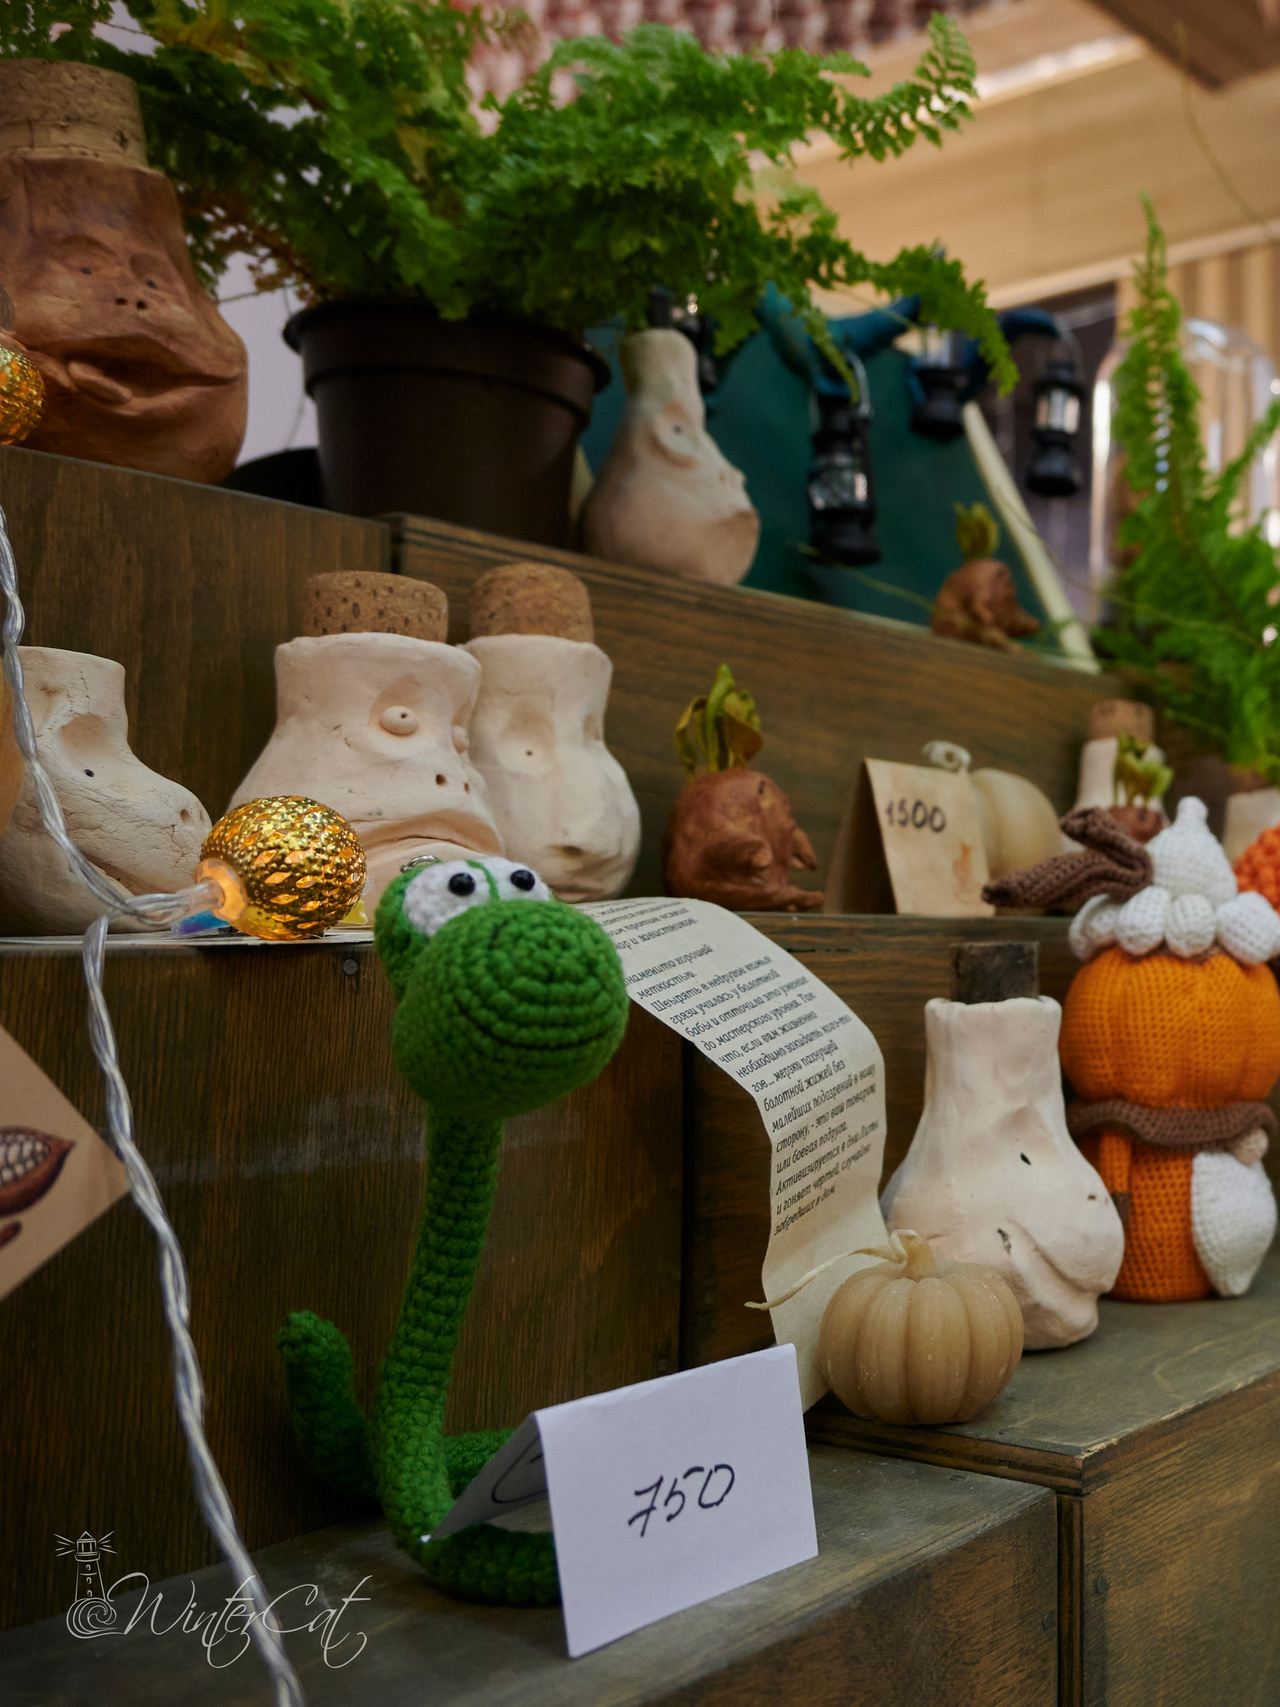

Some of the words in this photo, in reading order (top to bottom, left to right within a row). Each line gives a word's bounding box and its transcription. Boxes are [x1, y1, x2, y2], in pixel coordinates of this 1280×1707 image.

[886, 798, 946, 833] 1500
[632, 937, 640, 945] и
[638, 918, 698, 942] завистников.
[675, 944, 713, 964] хорошей
[637, 971, 697, 999] меткостью.
[650, 987, 702, 1012] Швырять
[708, 968, 746, 988] недругов
[745, 956, 772, 971] комья
[670, 1007, 698, 1025] грязи
[696, 992, 734, 1015] училась
[731, 988, 740, 999] у
[738, 969, 780, 993] болотной
[685, 1021, 713, 1037] бабы
[710, 1017, 720, 1026] и
[719, 996, 765, 1022] отточила
[763, 989, 781, 1001] это
[779, 976, 808, 996] умение
[701, 1040, 716, 1051] до
[716, 1013, 772, 1045] мастерского
[796, 992, 817, 1004] Так
[719, 1049, 744, 1063] что,
[741, 1038, 763, 1053] если
[761, 1029, 780, 1043] вам
[778, 1011, 817, 1034] жизненно
[736, 1047, 787, 1078] необходимо
[784, 1029, 823, 1053] закидать
[821, 1014, 852, 1034] кого-то
[751, 1079, 775, 1092] гов...
[773, 1060, 802, 1081] мерзко
[800, 1039, 838, 1066] пахнущей
[763, 1077, 804, 1111] болотной
[804, 1063, 833, 1089] жижей
[832, 1059, 846, 1073] без
[772, 1102, 812, 1133] малейших
[812, 1074, 853, 1109] подозрений
[859, 1064, 876, 1080] вашу
[776, 1125, 810, 1153] сторону,
[815, 1111, 829, 1128] это
[831, 1102, 846, 1119] ваш
[845, 1083, 876, 1110] товарищ
[776, 1156, 791, 1174] или
[792, 1141, 818, 1164] боевая
[776, 1146, 840, 1195] Активизируется
[846, 1132, 859, 1148] дни
[776, 1204, 782, 1215] и
[783, 1184, 812, 1211] гоняет
[628, 1463, 735, 1537] 750
